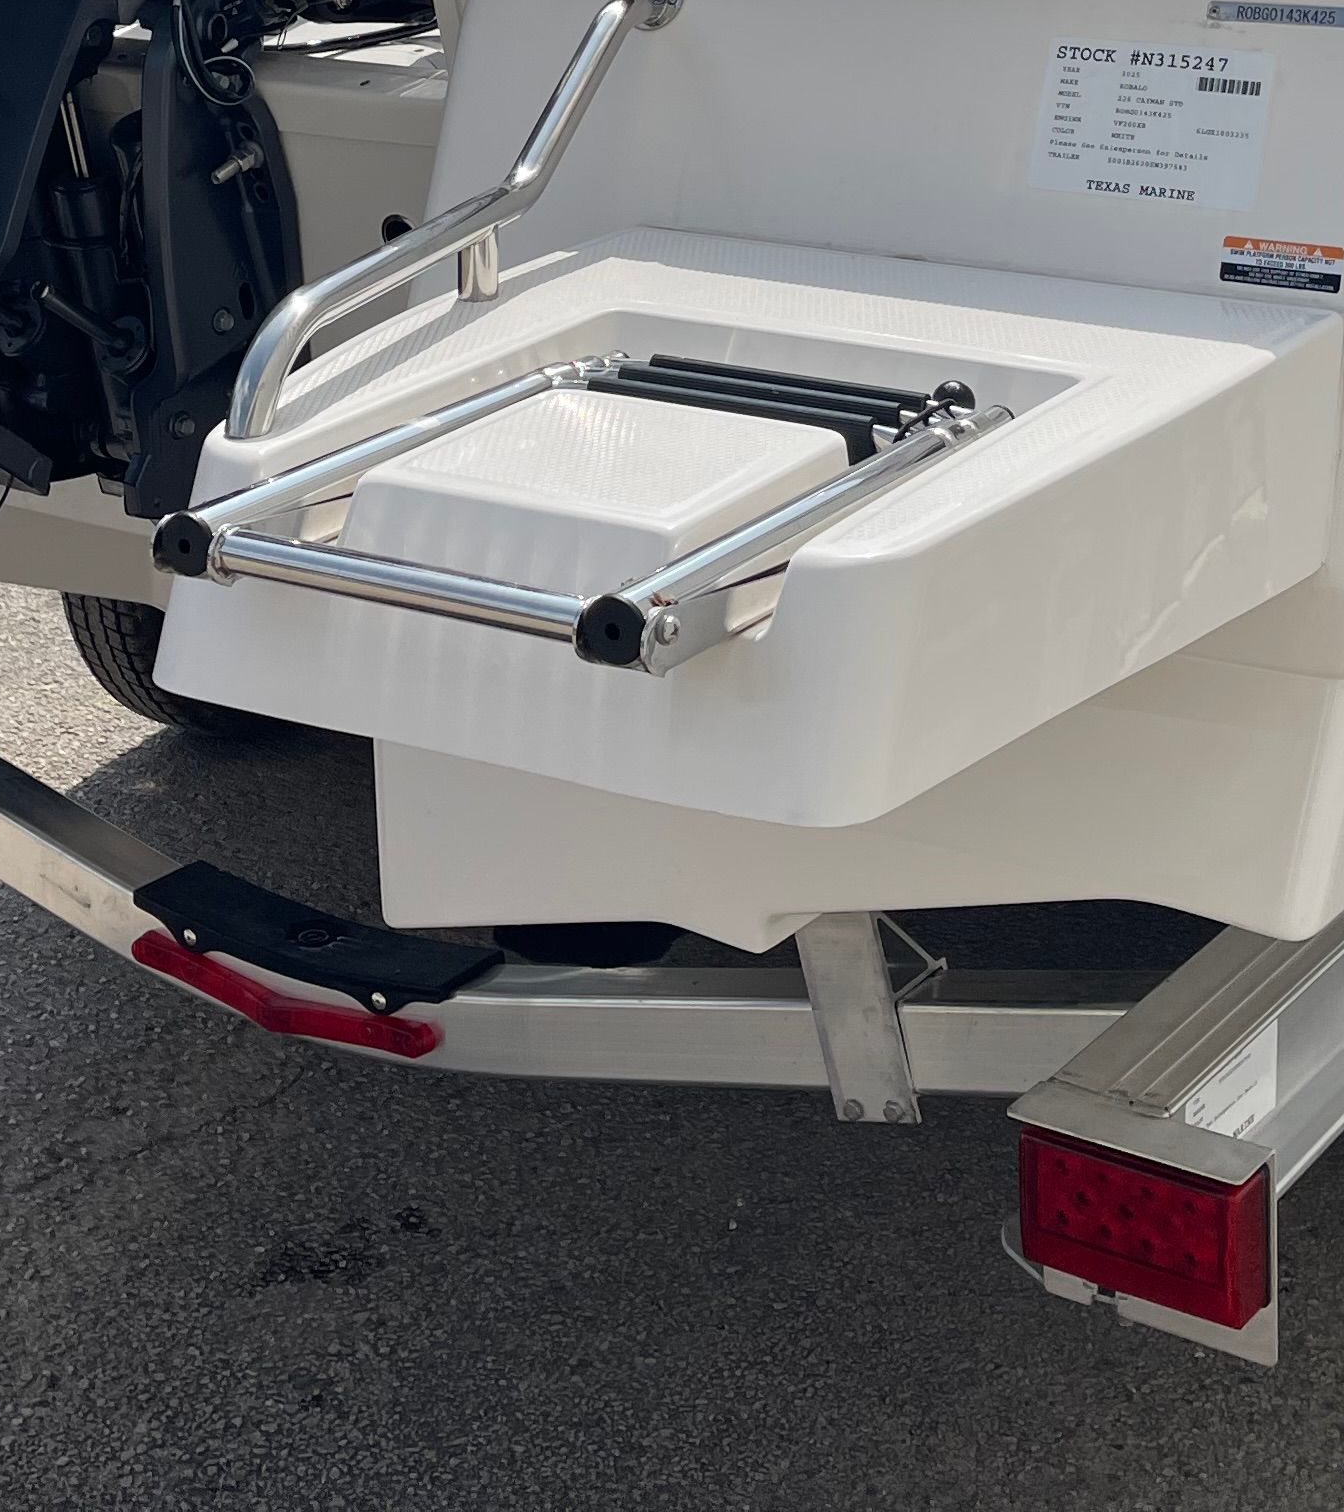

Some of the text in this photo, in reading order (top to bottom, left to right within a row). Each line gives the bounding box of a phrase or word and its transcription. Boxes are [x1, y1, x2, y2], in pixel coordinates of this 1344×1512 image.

[1056, 46, 1229, 73] STOCK #N315247
[1086, 179, 1196, 202] TEXAS MARINE
[1258, 240, 1309, 255] WARNING
